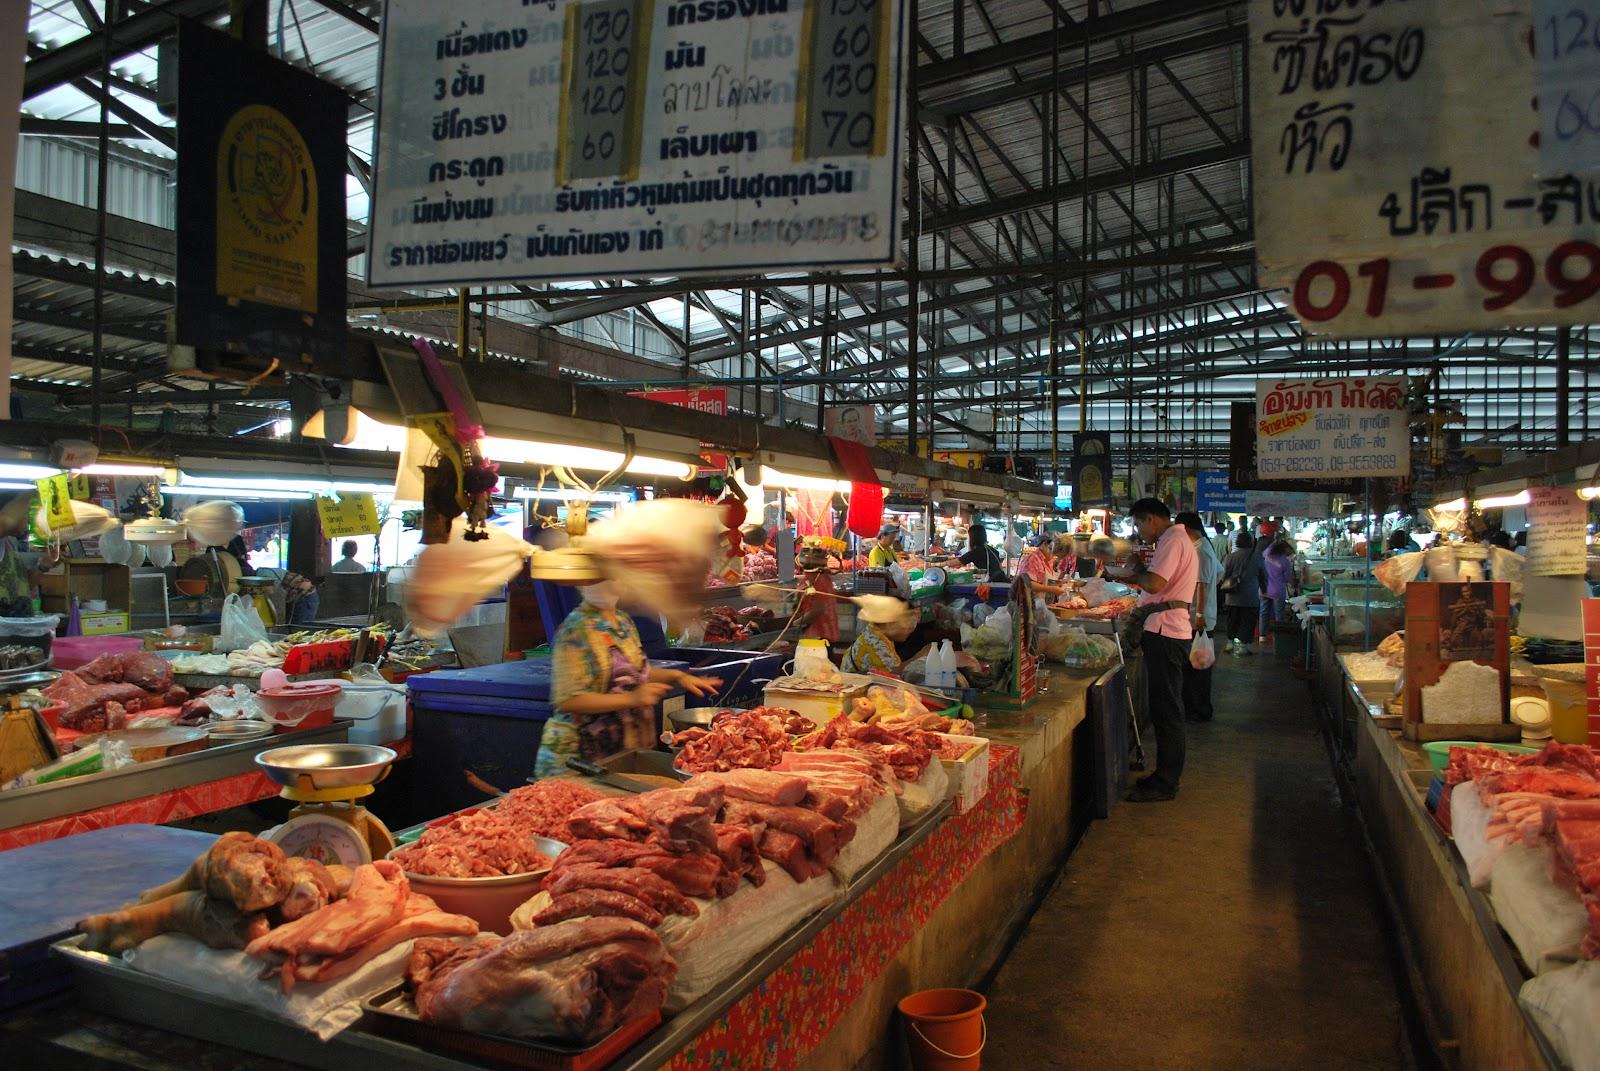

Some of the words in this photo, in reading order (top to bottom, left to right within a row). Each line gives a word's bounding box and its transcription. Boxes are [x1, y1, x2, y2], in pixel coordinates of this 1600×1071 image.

[436, 22, 528, 60] เนื้อแดง
[584, 9, 631, 44] 130
[833, 23, 871, 58] 60
[585, 47, 631, 79] 120
[664, 41, 706, 71] มัน
[434, 78, 446, 101] 3
[451, 63, 485, 98] ชั้น
[822, 63, 877, 98] 130
[582, 85, 625, 115] 120
[582, 131, 616, 161] 60
[822, 111, 876, 150] 70
[1279, 101, 1354, 174] หัว
[429, 154, 503, 187] กระดูก
[526, 224, 631, 258] เป็นกันเอง
